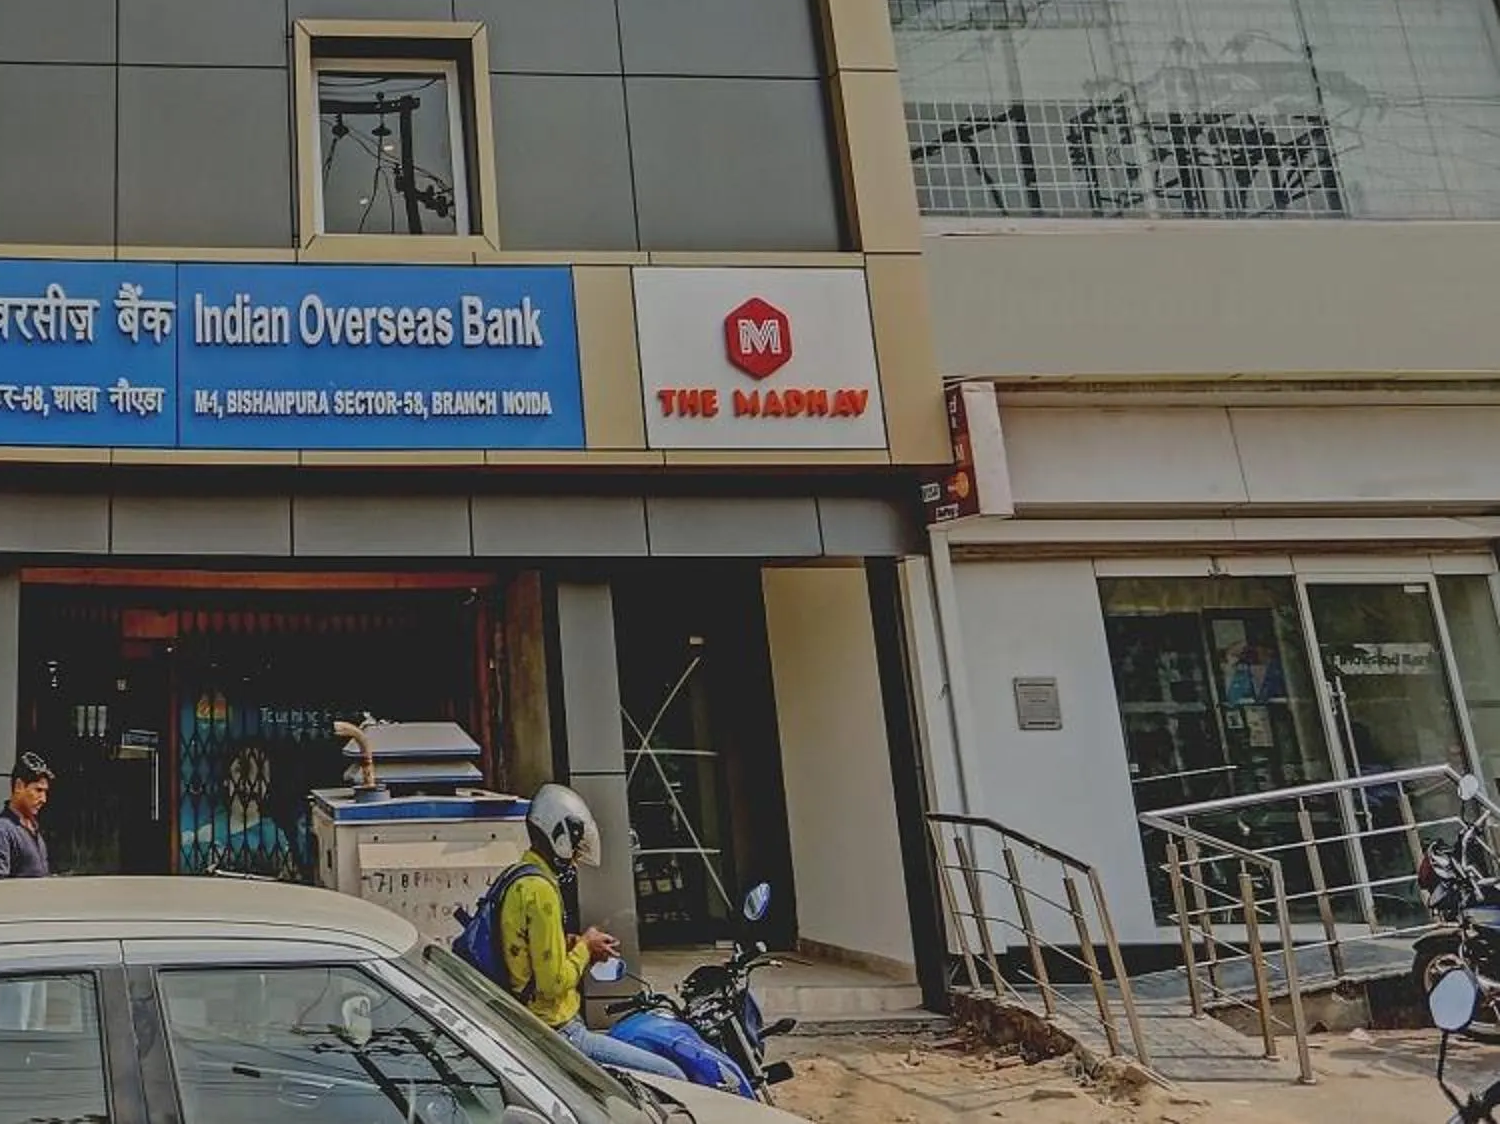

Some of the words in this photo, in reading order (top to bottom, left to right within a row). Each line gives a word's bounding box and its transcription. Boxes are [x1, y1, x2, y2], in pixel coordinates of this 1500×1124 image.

[114, 283, 177, 343] बैंक
[194, 293, 291, 346] Indian
[299, 293, 454, 348] Overseas
[460, 295, 544, 349] Bank
[226, 389, 329, 417] BISHANPURA
[431, 390, 498, 417] BRANCH
[502, 390, 553, 417] NOIDA
[657, 389, 719, 419] THE
[732, 389, 870, 419] MADHAV
